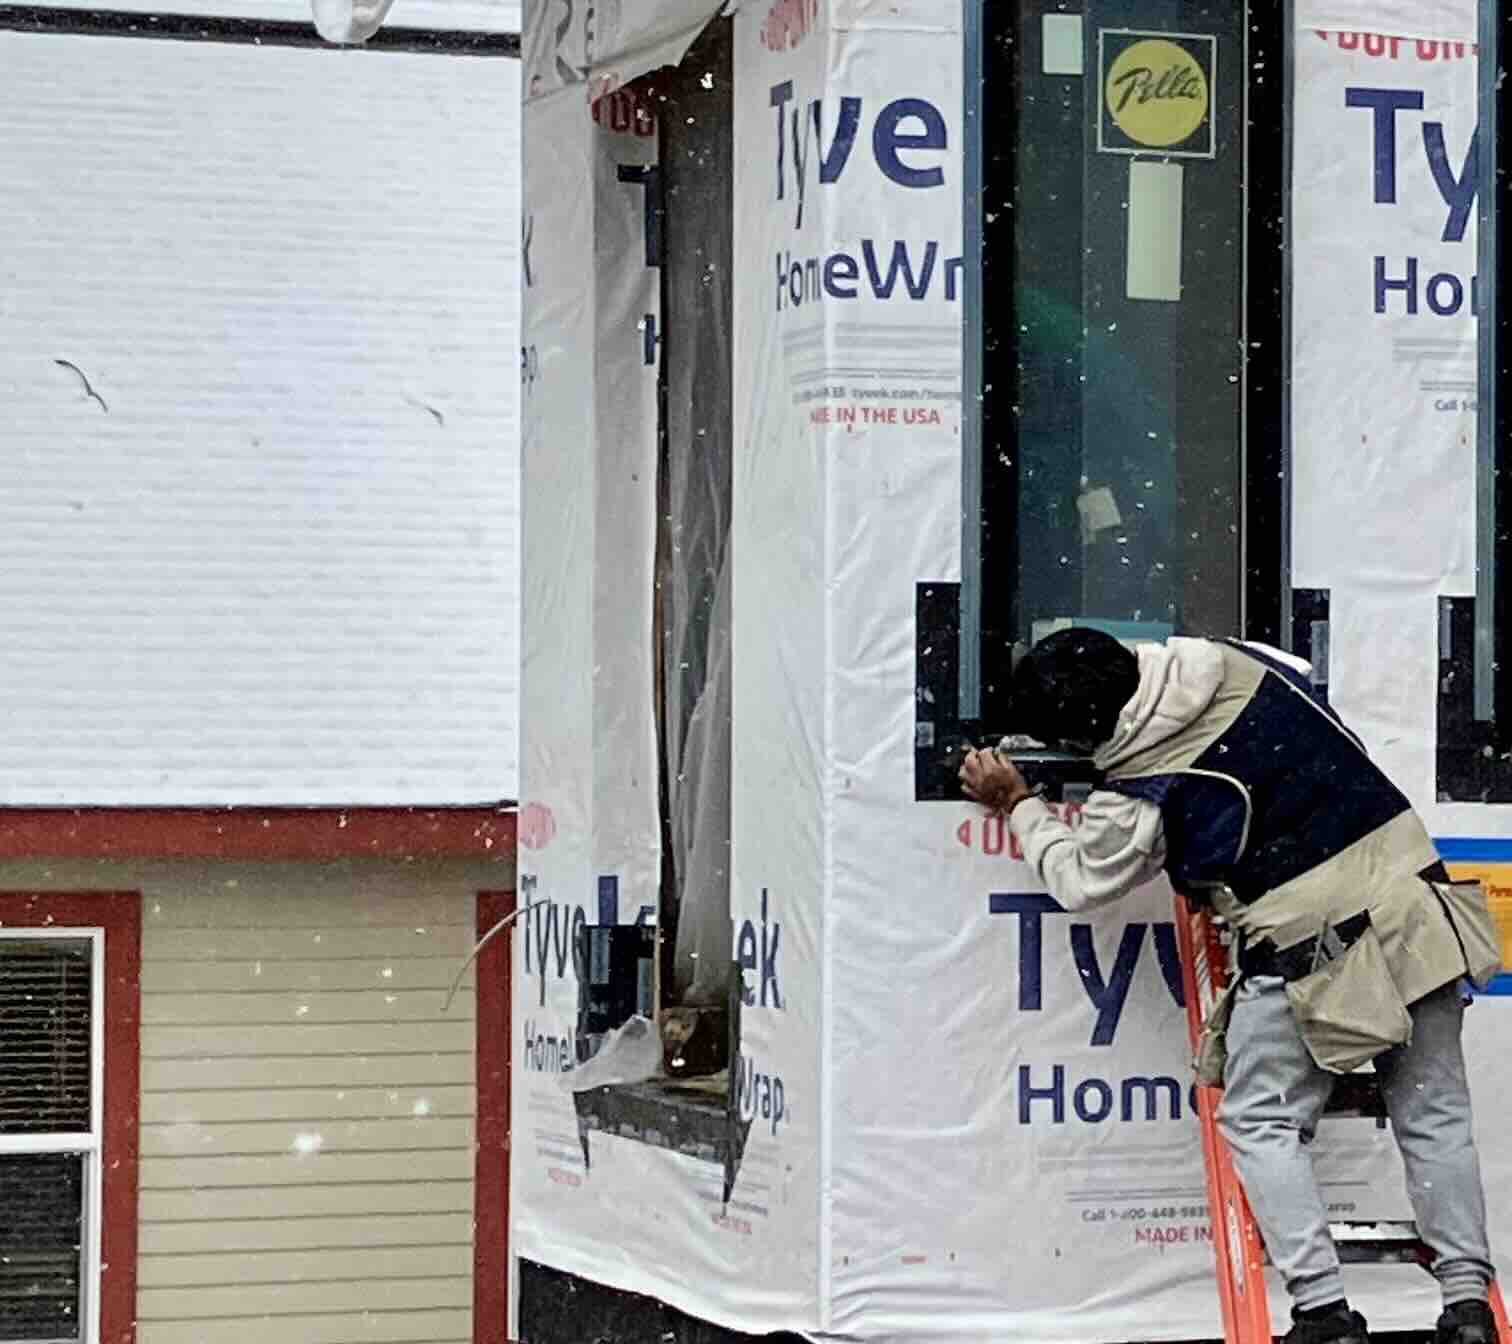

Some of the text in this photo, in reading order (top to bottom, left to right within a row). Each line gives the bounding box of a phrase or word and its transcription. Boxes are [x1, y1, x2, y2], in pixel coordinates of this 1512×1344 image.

[769, 79, 948, 229] Tyve
[838, 407, 856, 423] IN
[861, 408, 897, 424] THE
[903, 408, 941, 424] USA
[1135, 1226, 1189, 1243] MADE
